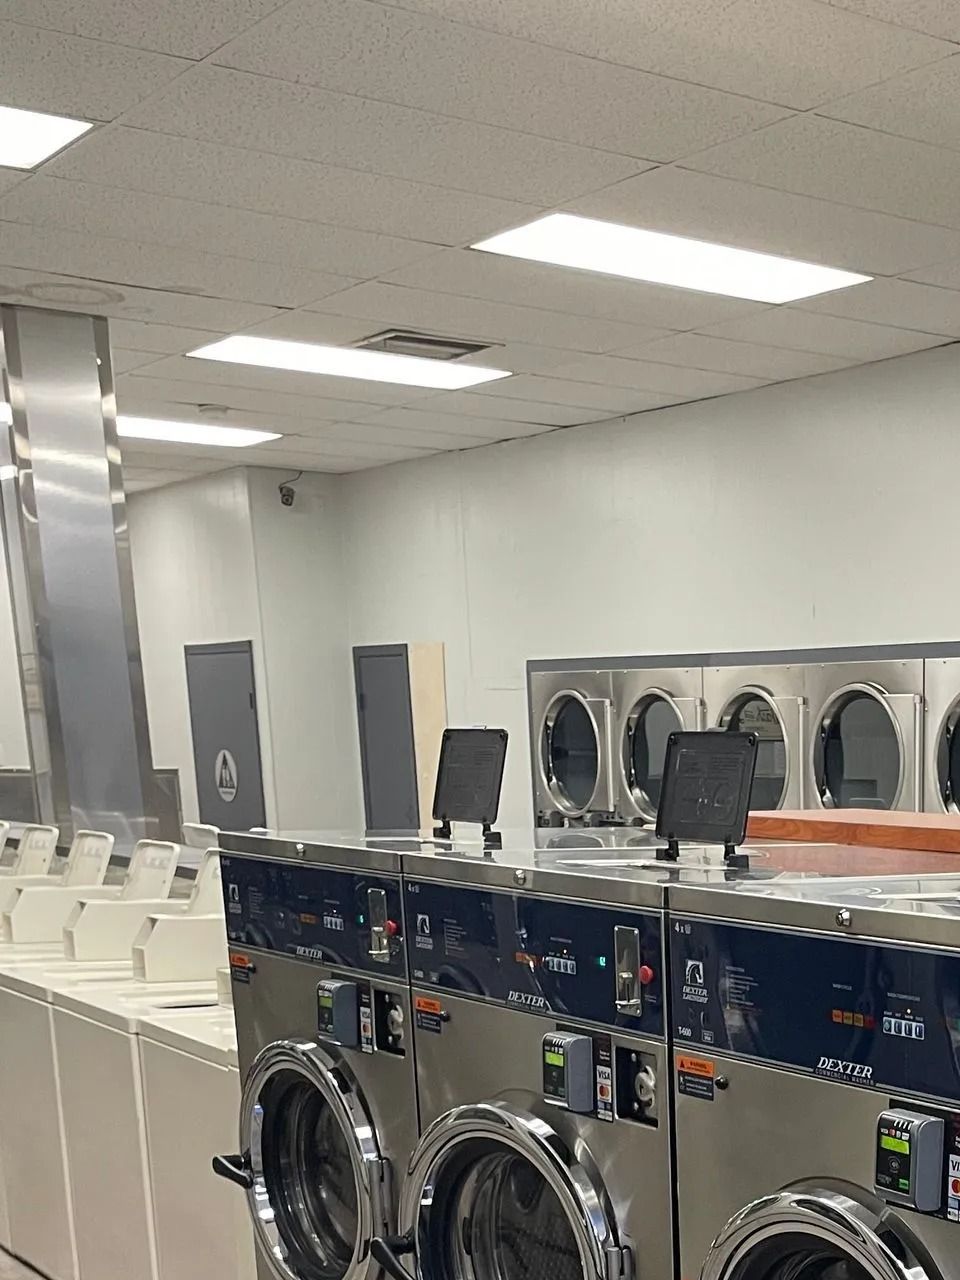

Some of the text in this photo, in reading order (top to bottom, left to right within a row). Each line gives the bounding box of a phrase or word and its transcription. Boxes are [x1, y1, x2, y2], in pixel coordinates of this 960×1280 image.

[674, 922, 680, 933] 4
[296, 946, 323, 959] DEXTER
[683, 986, 708, 997] DEXTER
[508, 991, 544, 1008] DEXTER
[817, 1056, 873, 1079] DEXTER
